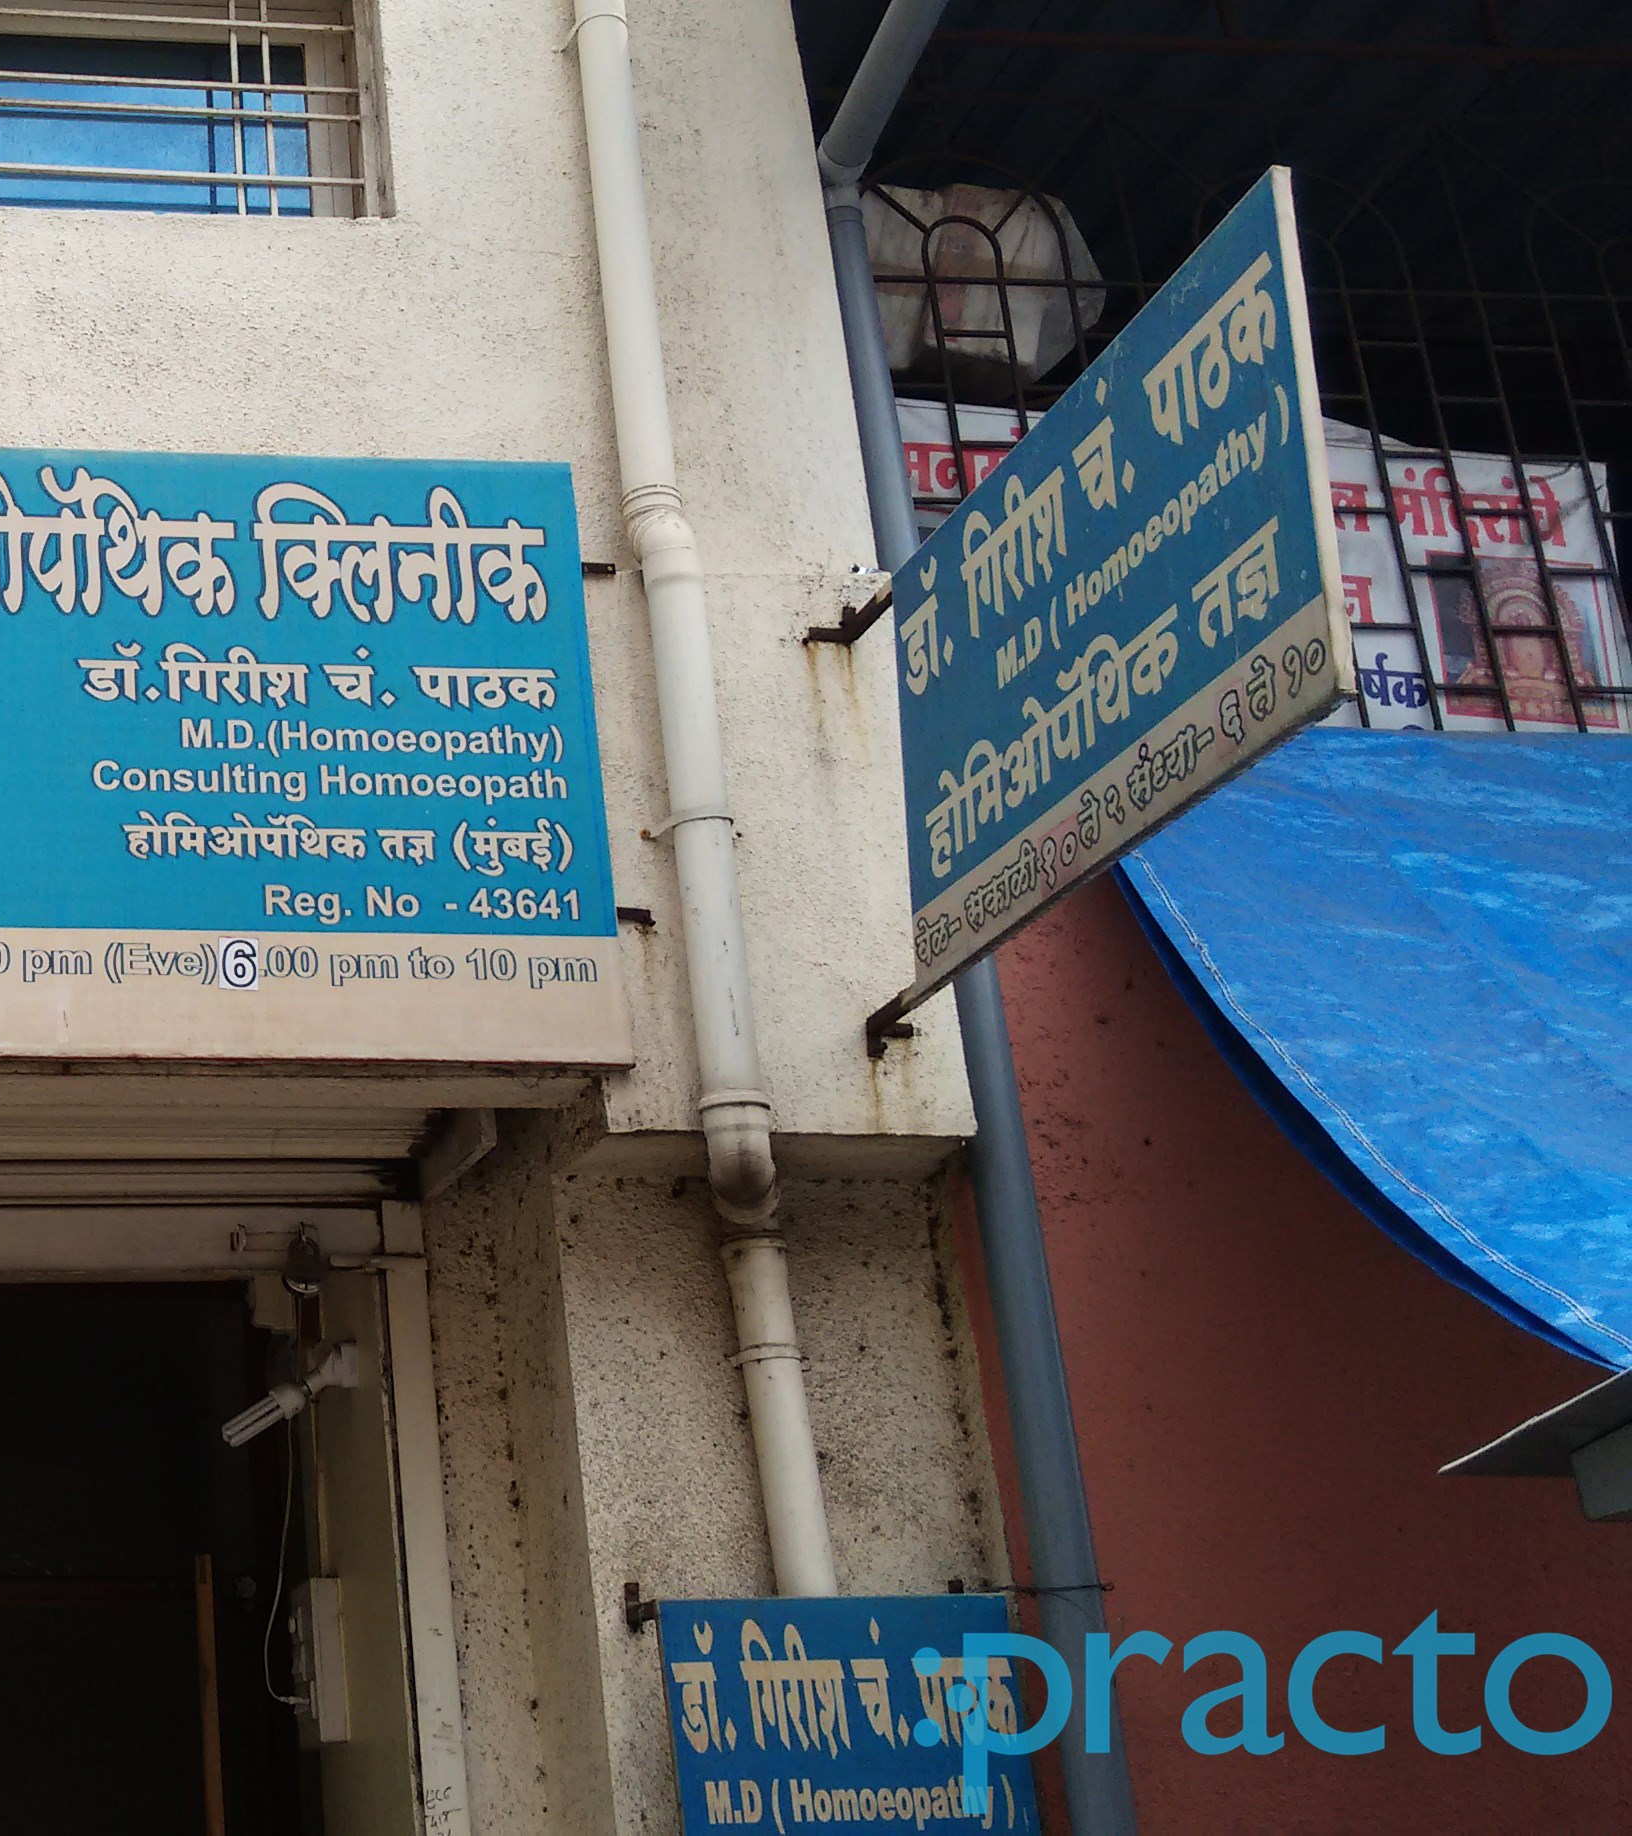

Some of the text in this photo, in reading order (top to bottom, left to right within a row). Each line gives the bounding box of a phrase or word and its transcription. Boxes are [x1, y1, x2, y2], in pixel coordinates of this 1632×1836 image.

[900, 556, 954, 695] डॉ.
[961, 465, 1067, 639] गिरीश
[1072, 377, 1136, 511] चं.
[1142, 251, 1276, 445] पाठक
[252, 481, 548, 625] क्लिनीक
[323, 646, 397, 708] चं.
[413, 667, 557, 710] पाठक
[996, 616, 1042, 689] M.D
[925, 516, 1279, 879] होमिओपॅथिक तज्ञ
[92, 760, 569, 805] Consulting Homoeopath
[1077, 790, 1101, 849] ते
[1246, 654, 1275, 722] ते
[121, 811, 574, 875] होमिओपॅथिक तज्ञ (मुंबई)
[264, 884, 352, 924] Reg.
[366, 886, 420, 918] No
[469, 889, 581, 920] 43641
[22, 946, 93, 984] pm
[330, 952, 399, 987] pm
[408, 947, 456, 980] to
[466, 949, 517, 982] 10
[529, 954, 598, 989] pm
[671, 1620, 737, 1753] डॉ.
[739, 1619, 851, 1760] गिरीश
[850, 1617, 909, 1748] चं.
[704, 1780, 763, 1825] M.D
